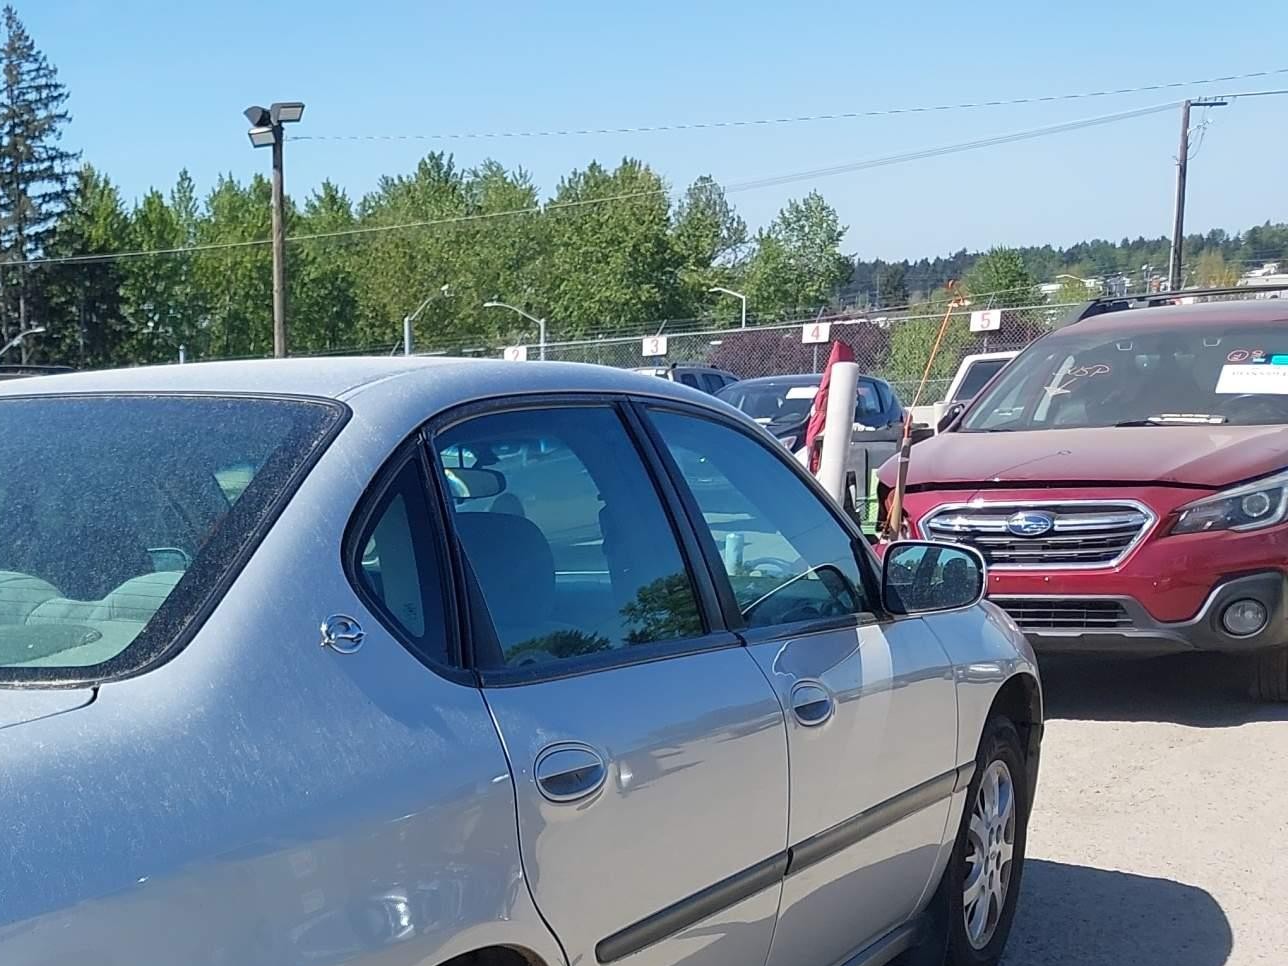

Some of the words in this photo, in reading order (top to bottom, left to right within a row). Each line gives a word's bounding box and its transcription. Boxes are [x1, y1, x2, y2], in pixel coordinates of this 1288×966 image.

[980, 312, 992, 330] 5
[810, 325, 821, 341] 4
[650, 339, 659, 354] 3
